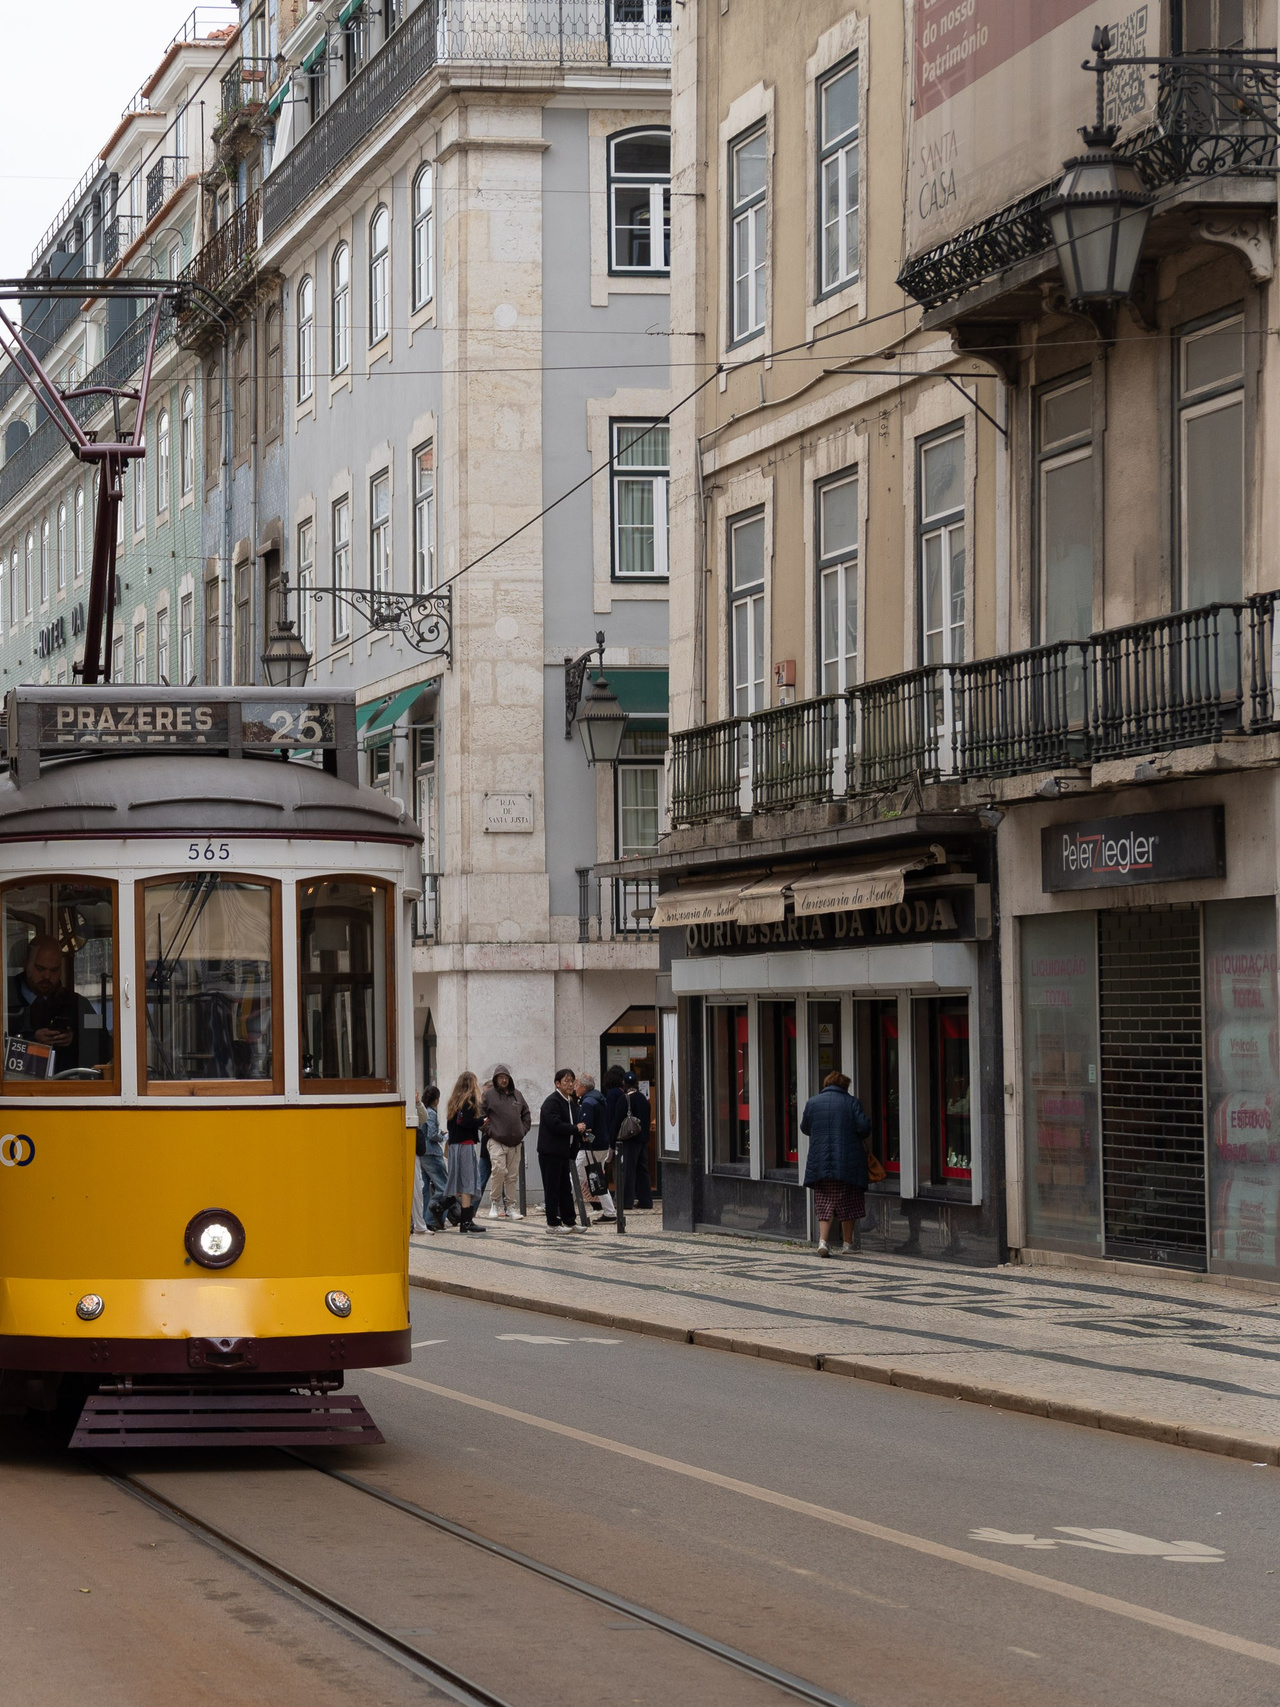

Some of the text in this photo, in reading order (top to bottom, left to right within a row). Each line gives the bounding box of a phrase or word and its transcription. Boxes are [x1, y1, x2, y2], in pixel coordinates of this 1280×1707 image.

[923, 0, 975, 48] do nosso
[922, 23, 988, 87] Património
[920, 129, 957, 178] SANTA
[919, 168, 957, 220] CASA
[38, 602, 85, 659] HOTEL DA
[56, 706, 213, 731] PRAZERES
[269, 710, 323, 743] 25
[188, 843, 230, 860] 565
[851, 888, 864, 905] da
[686, 899, 957, 950] OURIVESARIA DA MODA
[1044, 989, 1072, 1007] TOTAL
[1232, 987, 1264, 1008] TOTAL
[11, 1042, 27, 1053] 25E
[8, 1058, 24, 1071] 03
